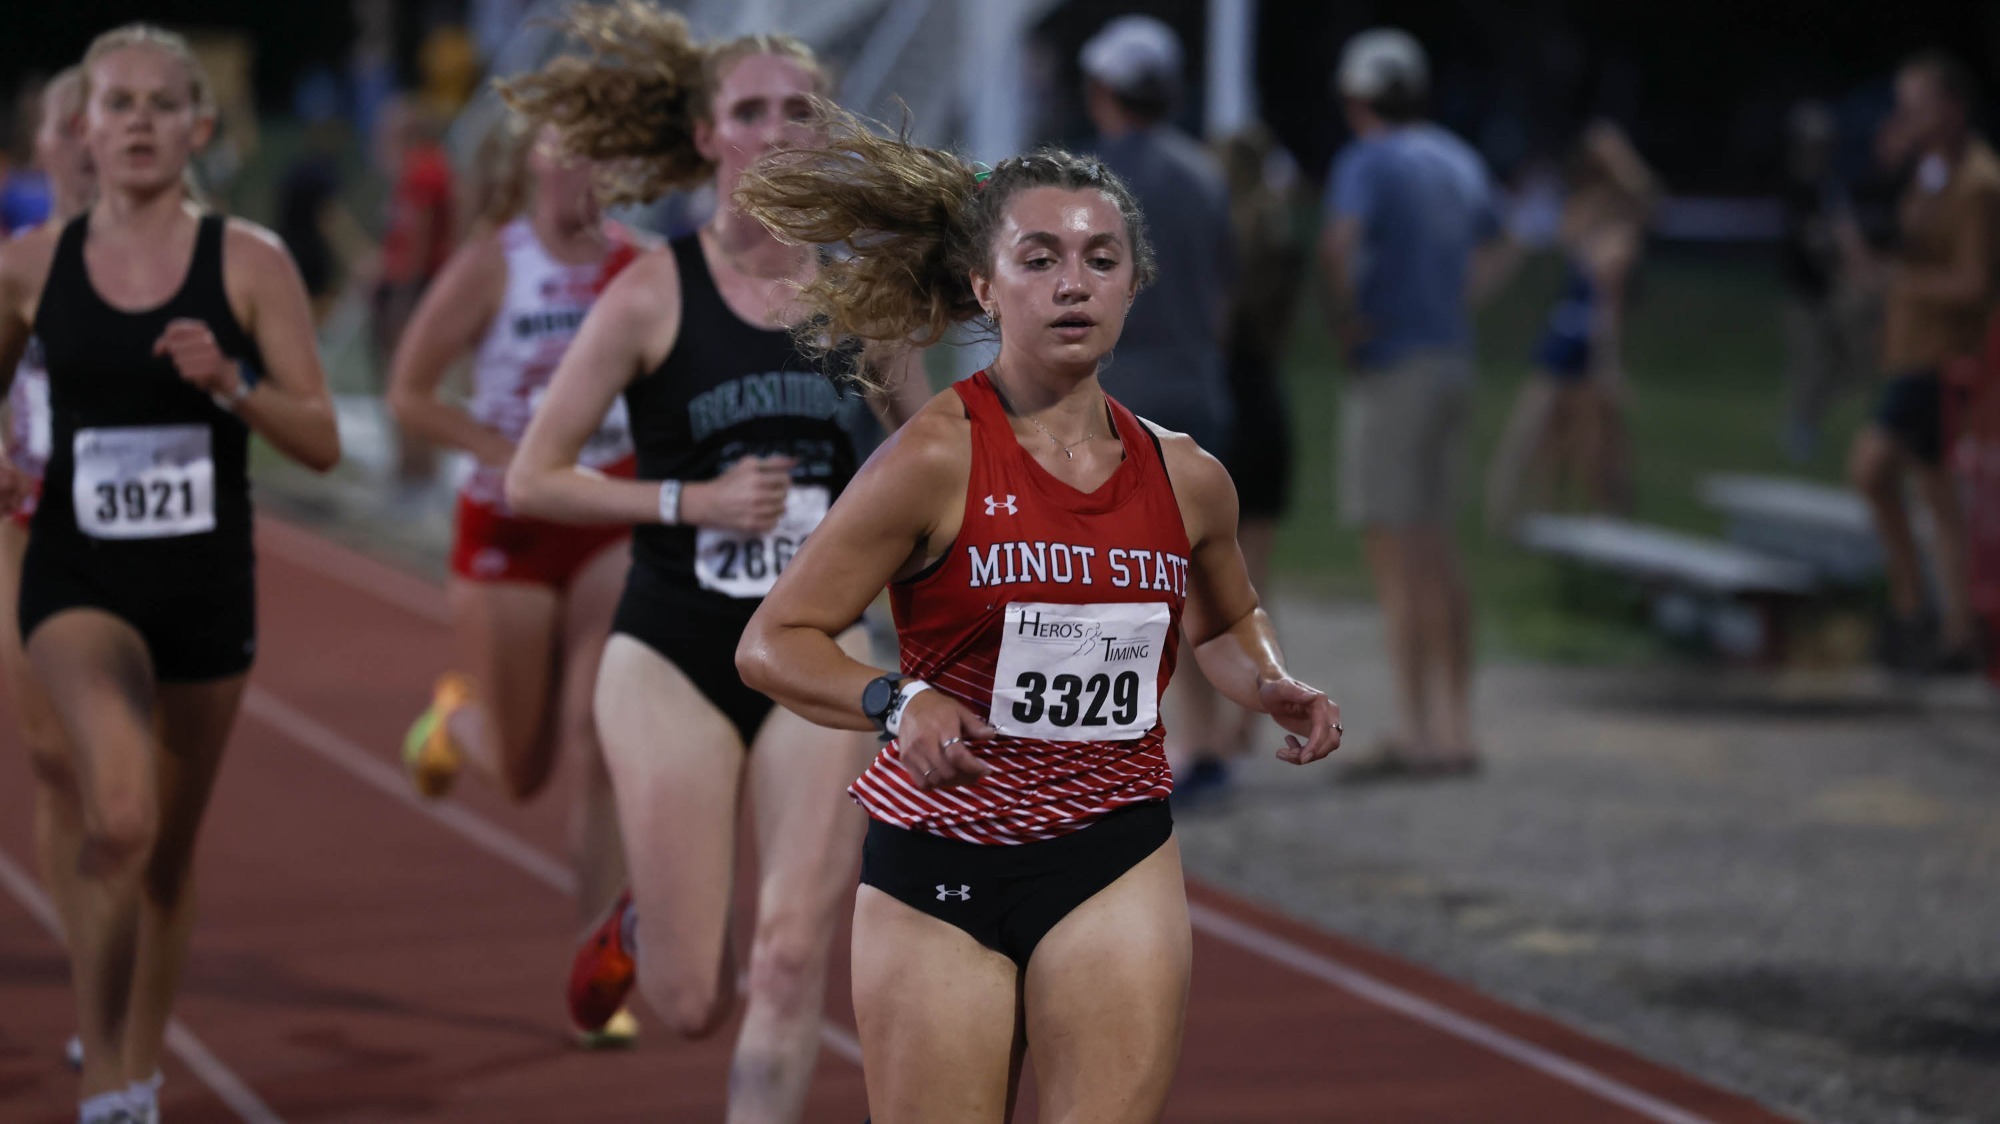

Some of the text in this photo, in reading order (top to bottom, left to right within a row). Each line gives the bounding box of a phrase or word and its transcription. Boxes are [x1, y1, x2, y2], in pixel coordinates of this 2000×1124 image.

[96, 480, 194, 523] 3921
[716, 536, 810, 580] 286
[967, 541, 1188, 598] MINOT STATE
[1017, 610, 1083, 638] HERO'S
[1100, 637, 1149, 662] TIMING
[1011, 671, 1140, 728] 3329
